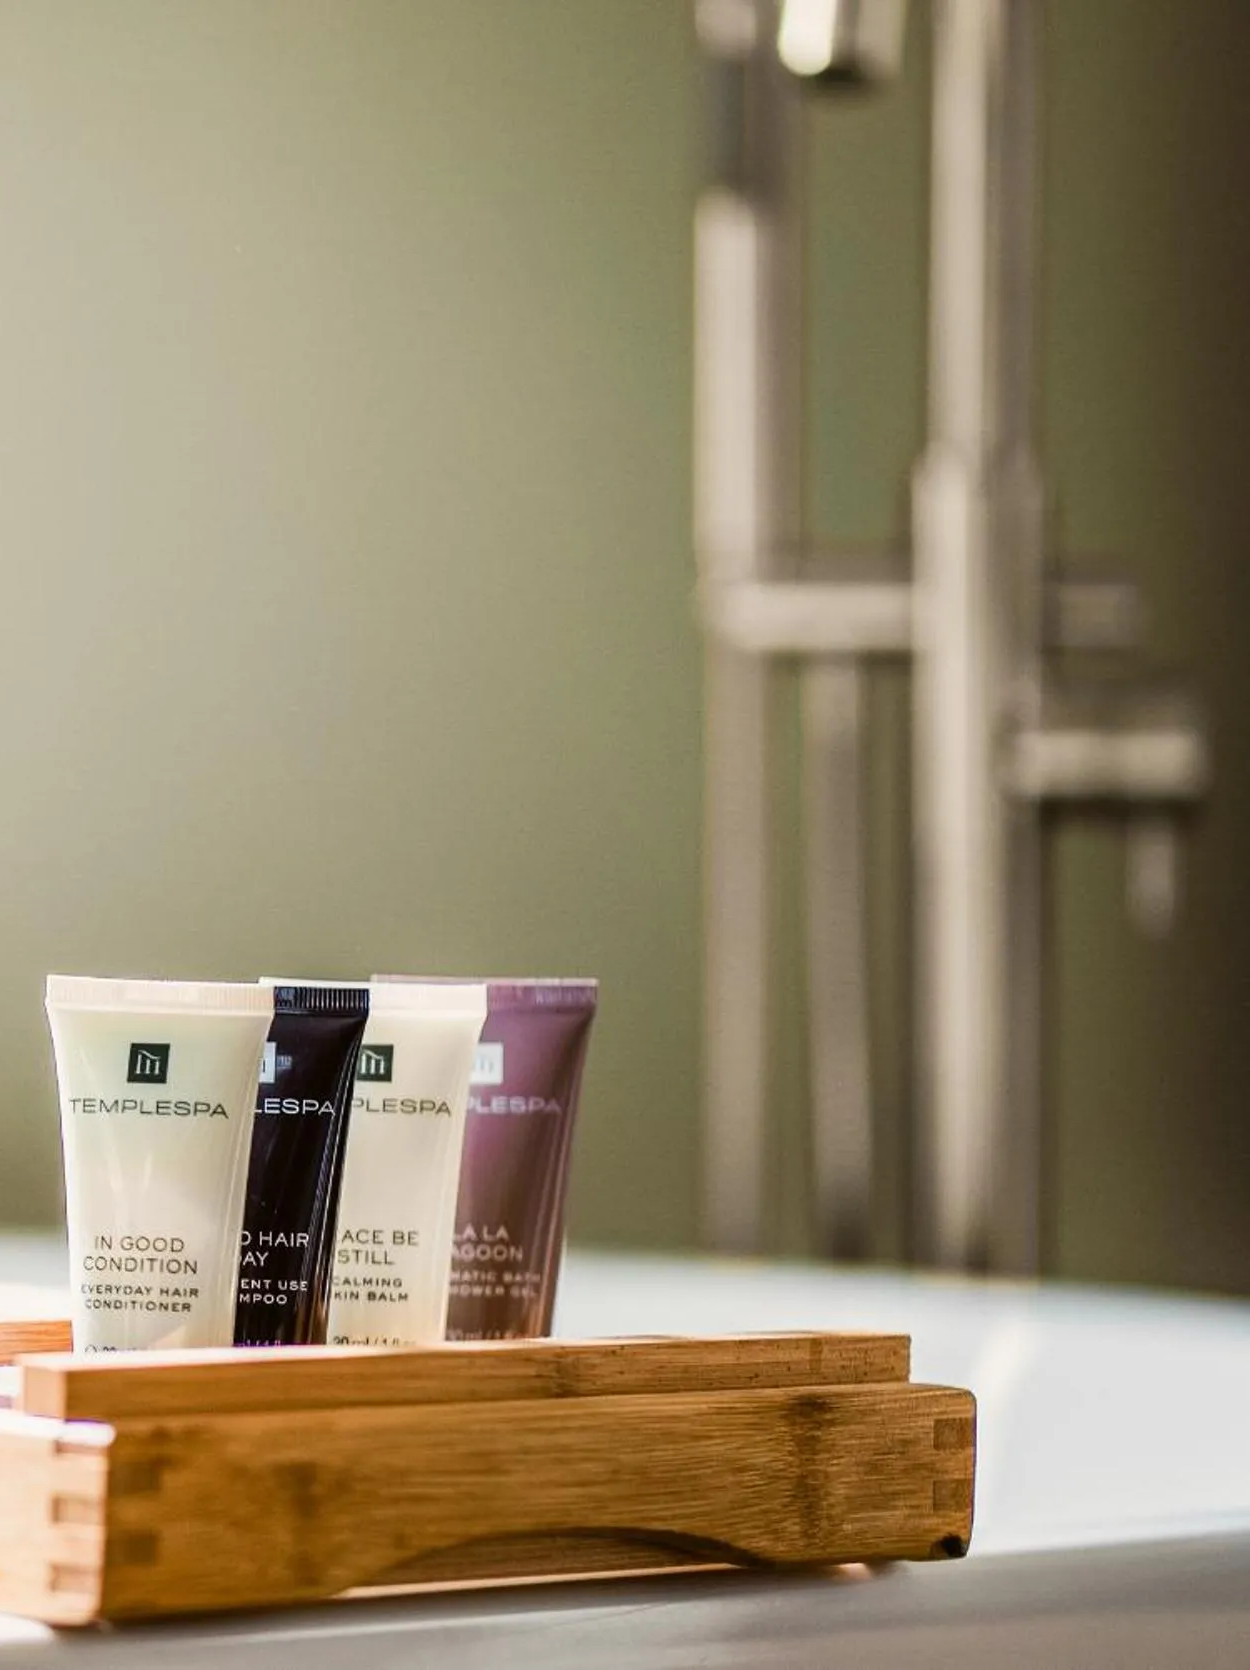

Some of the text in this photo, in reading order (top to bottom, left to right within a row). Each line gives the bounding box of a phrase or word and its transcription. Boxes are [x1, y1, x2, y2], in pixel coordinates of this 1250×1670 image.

[69, 1098, 229, 1119] TEMPLESPA
[94, 1236, 185, 1253] IN GOOD
[259, 1231, 309, 1248] HAIR
[393, 1230, 419, 1246] BE
[83, 1256, 198, 1275] CONDITION
[337, 1250, 395, 1266] STILL
[81, 1284, 200, 1298] EVERYDAY HAIR
[278, 1280, 308, 1291] USE
[368, 1291, 408, 1302] BALM
[85, 1299, 192, 1313] CONDITIONER
